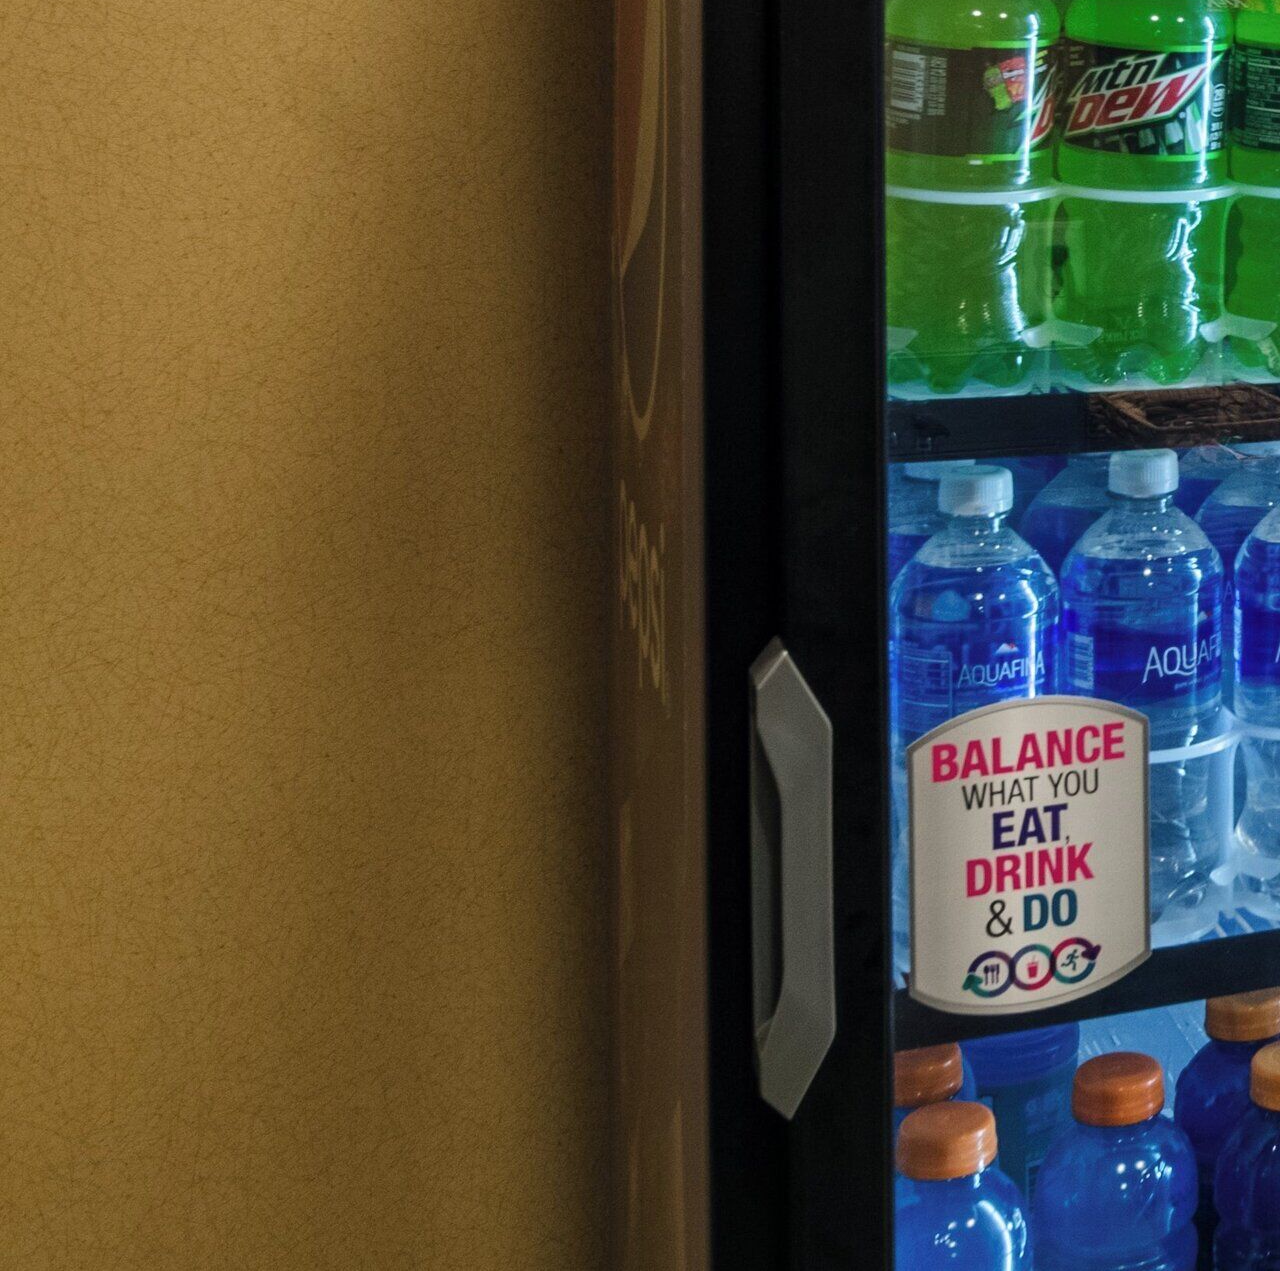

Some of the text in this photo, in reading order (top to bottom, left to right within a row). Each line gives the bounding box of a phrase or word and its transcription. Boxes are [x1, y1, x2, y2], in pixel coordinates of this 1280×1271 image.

[1072, 55, 1158, 97] Mtn
[957, 651, 1045, 689] AQUAFINA
[1141, 634, 1222, 684] AQUAF
[931, 722, 1126, 783] BALANCE
[961, 768, 1099, 811] WHAT YOU
[992, 803, 1070, 850] EAT,
[966, 842, 1095, 898] DRINK
[985, 888, 1078, 938] & DO
